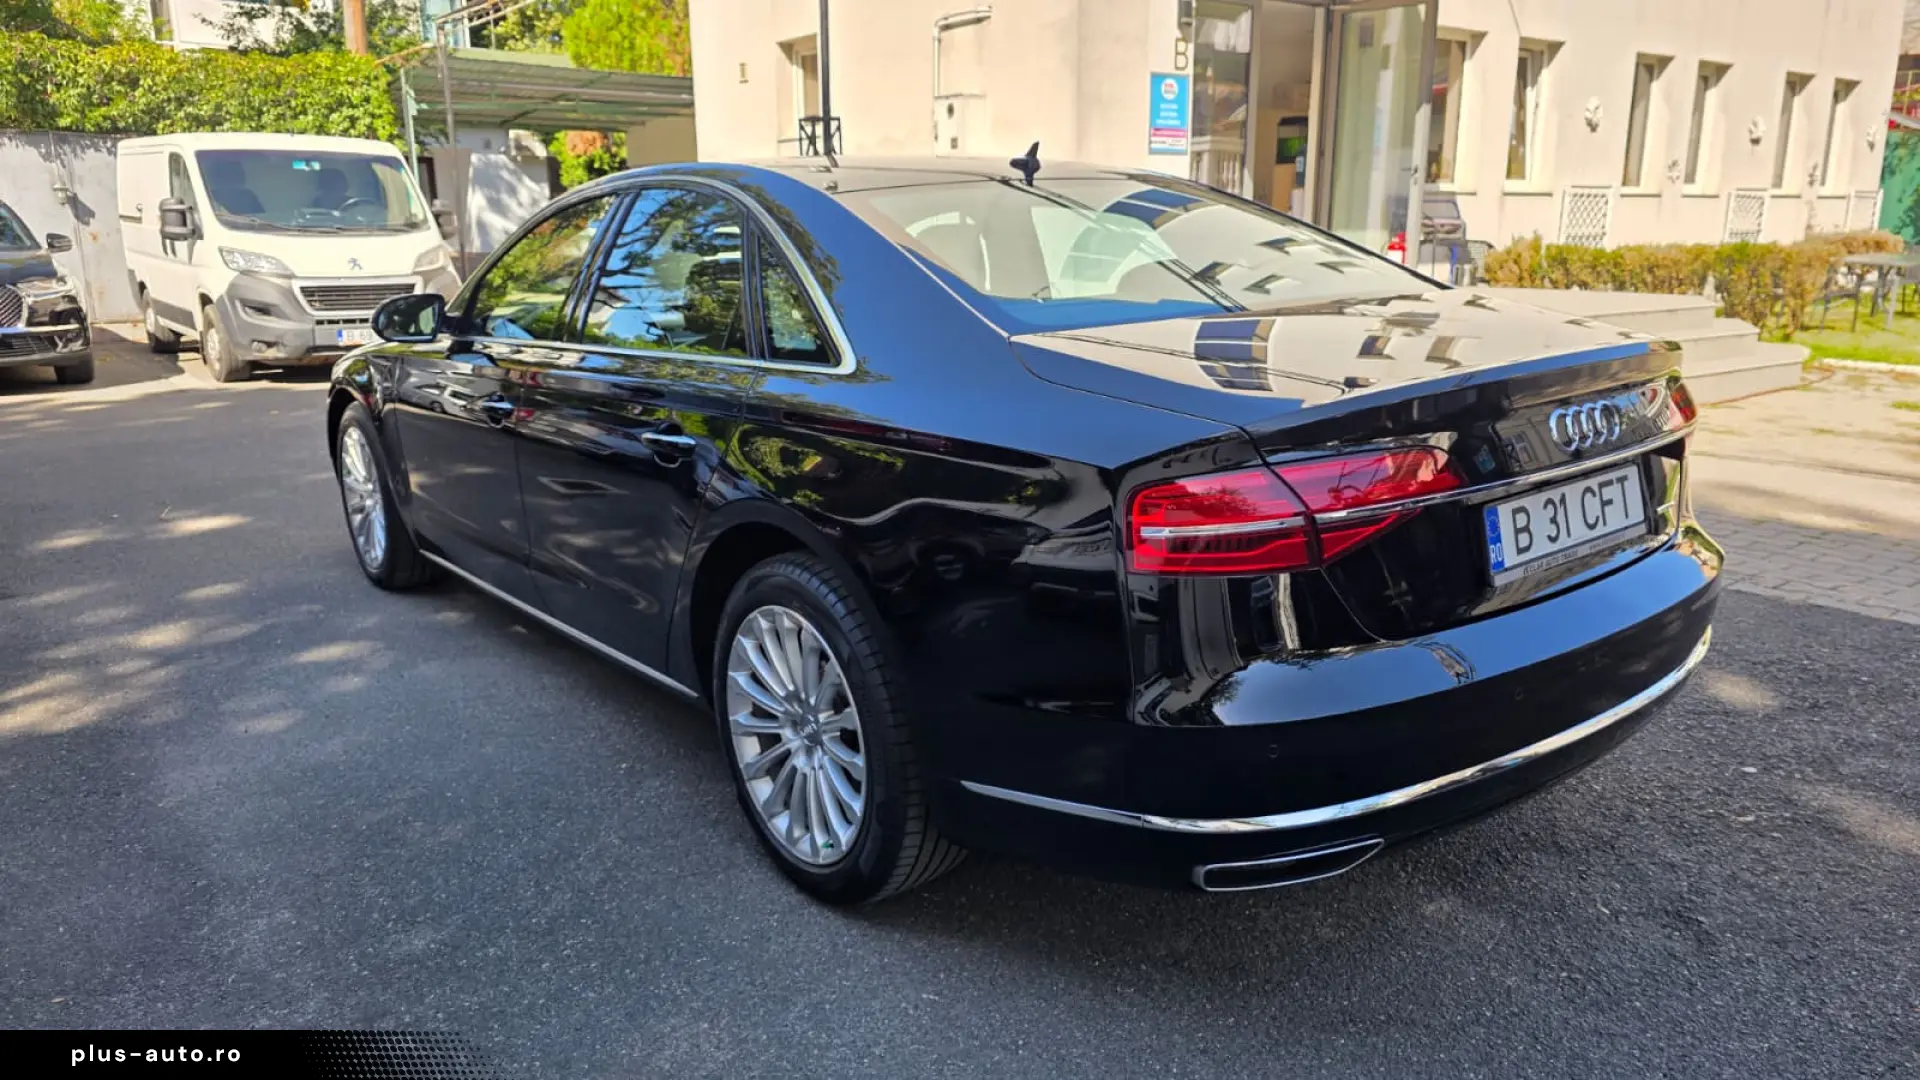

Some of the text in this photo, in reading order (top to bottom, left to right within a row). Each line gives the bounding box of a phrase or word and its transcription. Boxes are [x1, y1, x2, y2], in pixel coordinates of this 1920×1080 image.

[1174, 36, 1189, 71] B
[1511, 474, 1629, 557] B 31 CFT
[1489, 544, 1504, 565] RO
